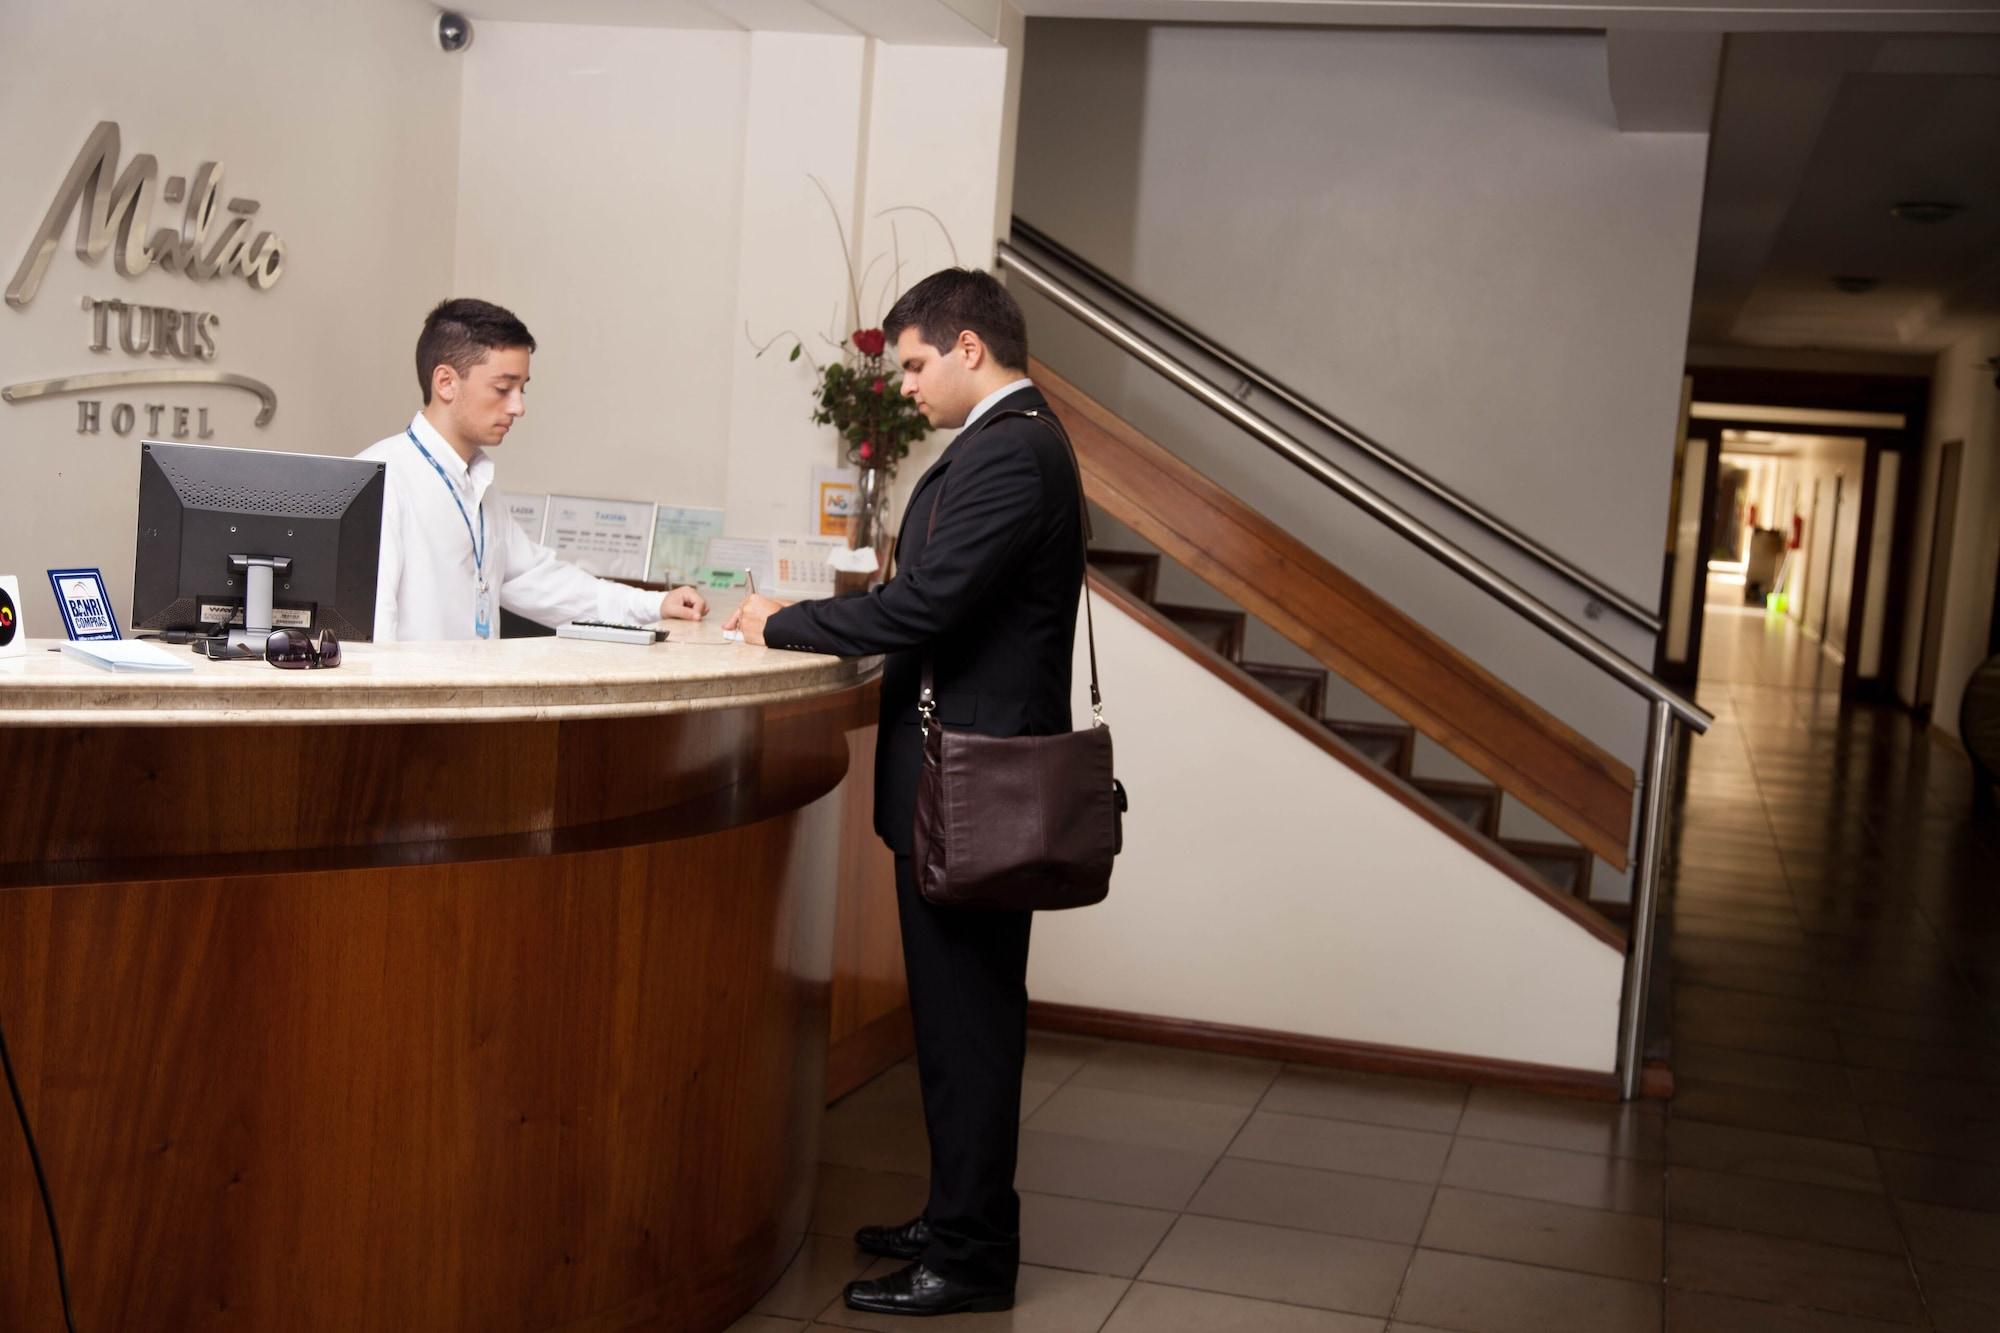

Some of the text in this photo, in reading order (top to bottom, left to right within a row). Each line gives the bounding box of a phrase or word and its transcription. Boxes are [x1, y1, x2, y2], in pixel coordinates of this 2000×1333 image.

[82, 296, 219, 361] TURIS
[77, 401, 214, 439] HOTEL
[69, 598, 104, 617] BANRI
[74, 615, 108, 629] COMPRAS
